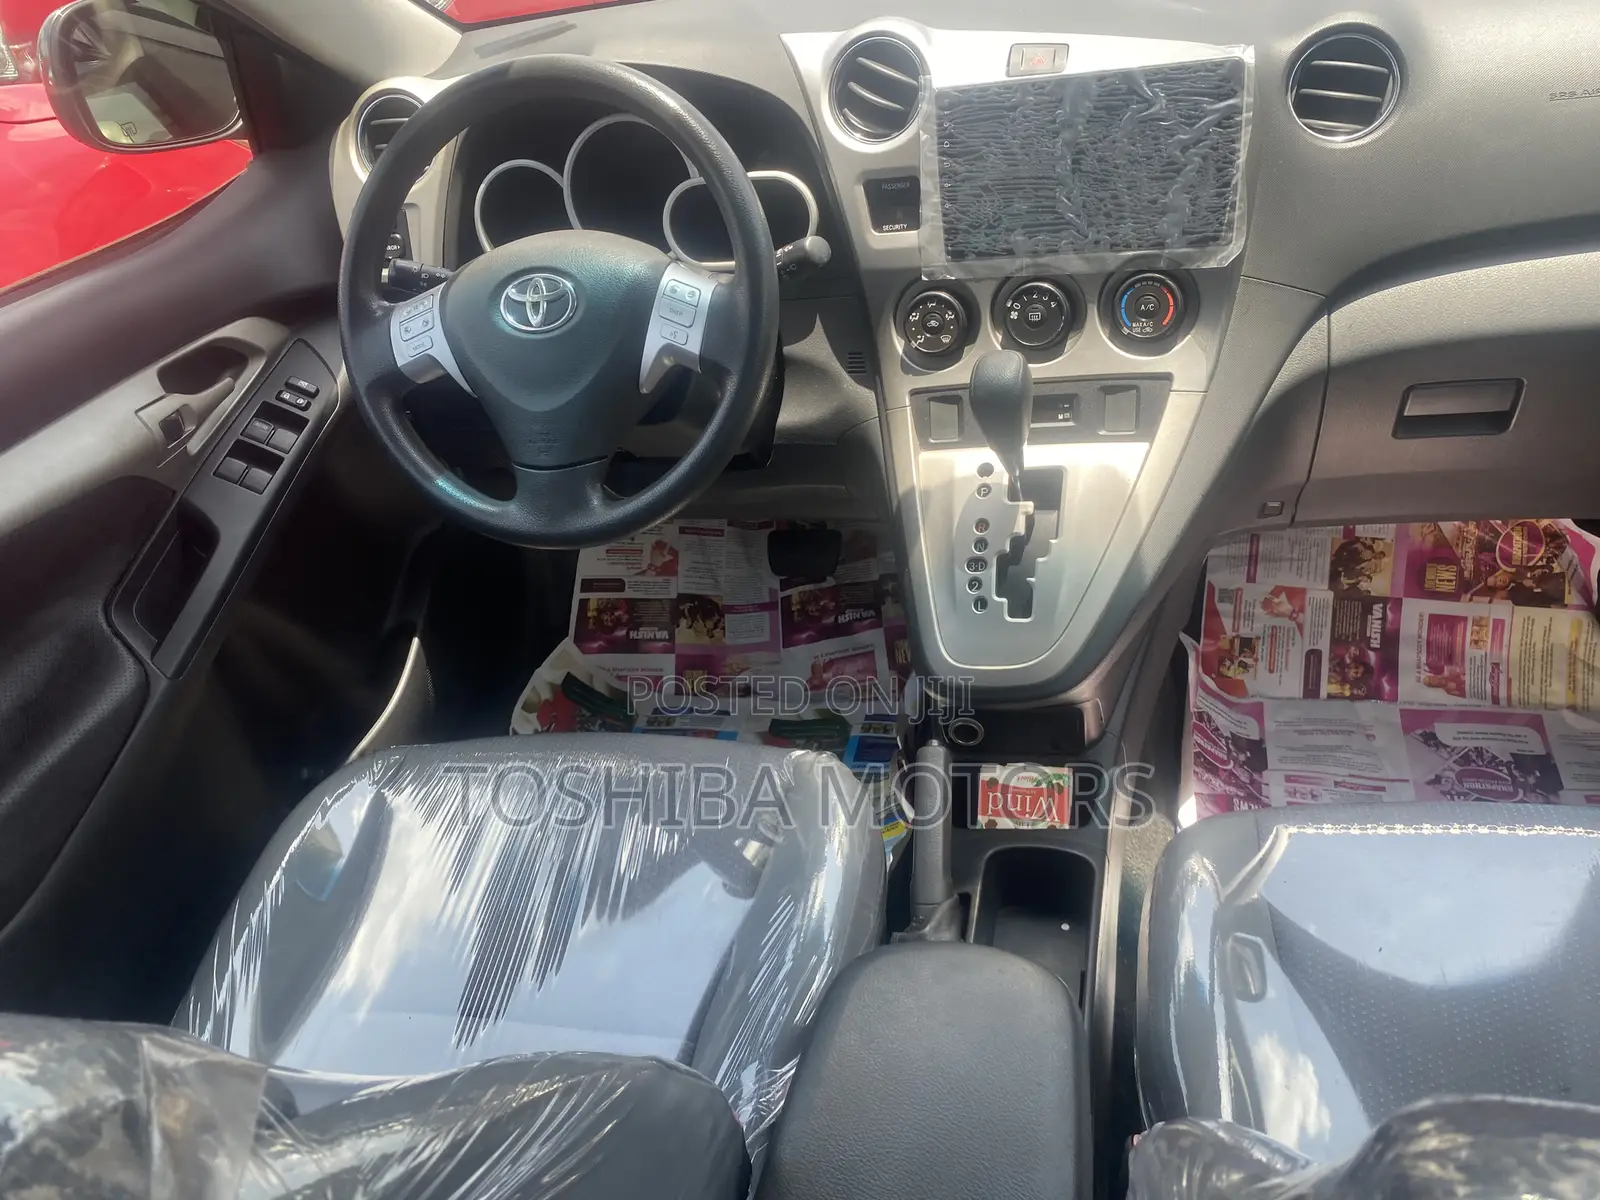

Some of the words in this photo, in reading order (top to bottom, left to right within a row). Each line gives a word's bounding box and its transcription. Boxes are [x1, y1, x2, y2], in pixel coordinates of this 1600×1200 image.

[881, 181, 911, 191] PASSENGER
[882, 223, 908, 231] SECURITY
[669, 307, 684, 316] DISP
[1140, 303, 1155, 311] A/C
[980, 487, 989, 497] P
[977, 522, 986, 532] R
[976, 542, 986, 552] N
[1435, 563, 1458, 593] NEWS
[971, 581, 979, 592] 2
[977, 601, 984, 611] L
[837, 609, 876, 625] VANISH
[1368, 601, 1383, 649] VANISH
[629, 629, 670, 641] VANISH
[986, 791, 1061, 823] Wind
